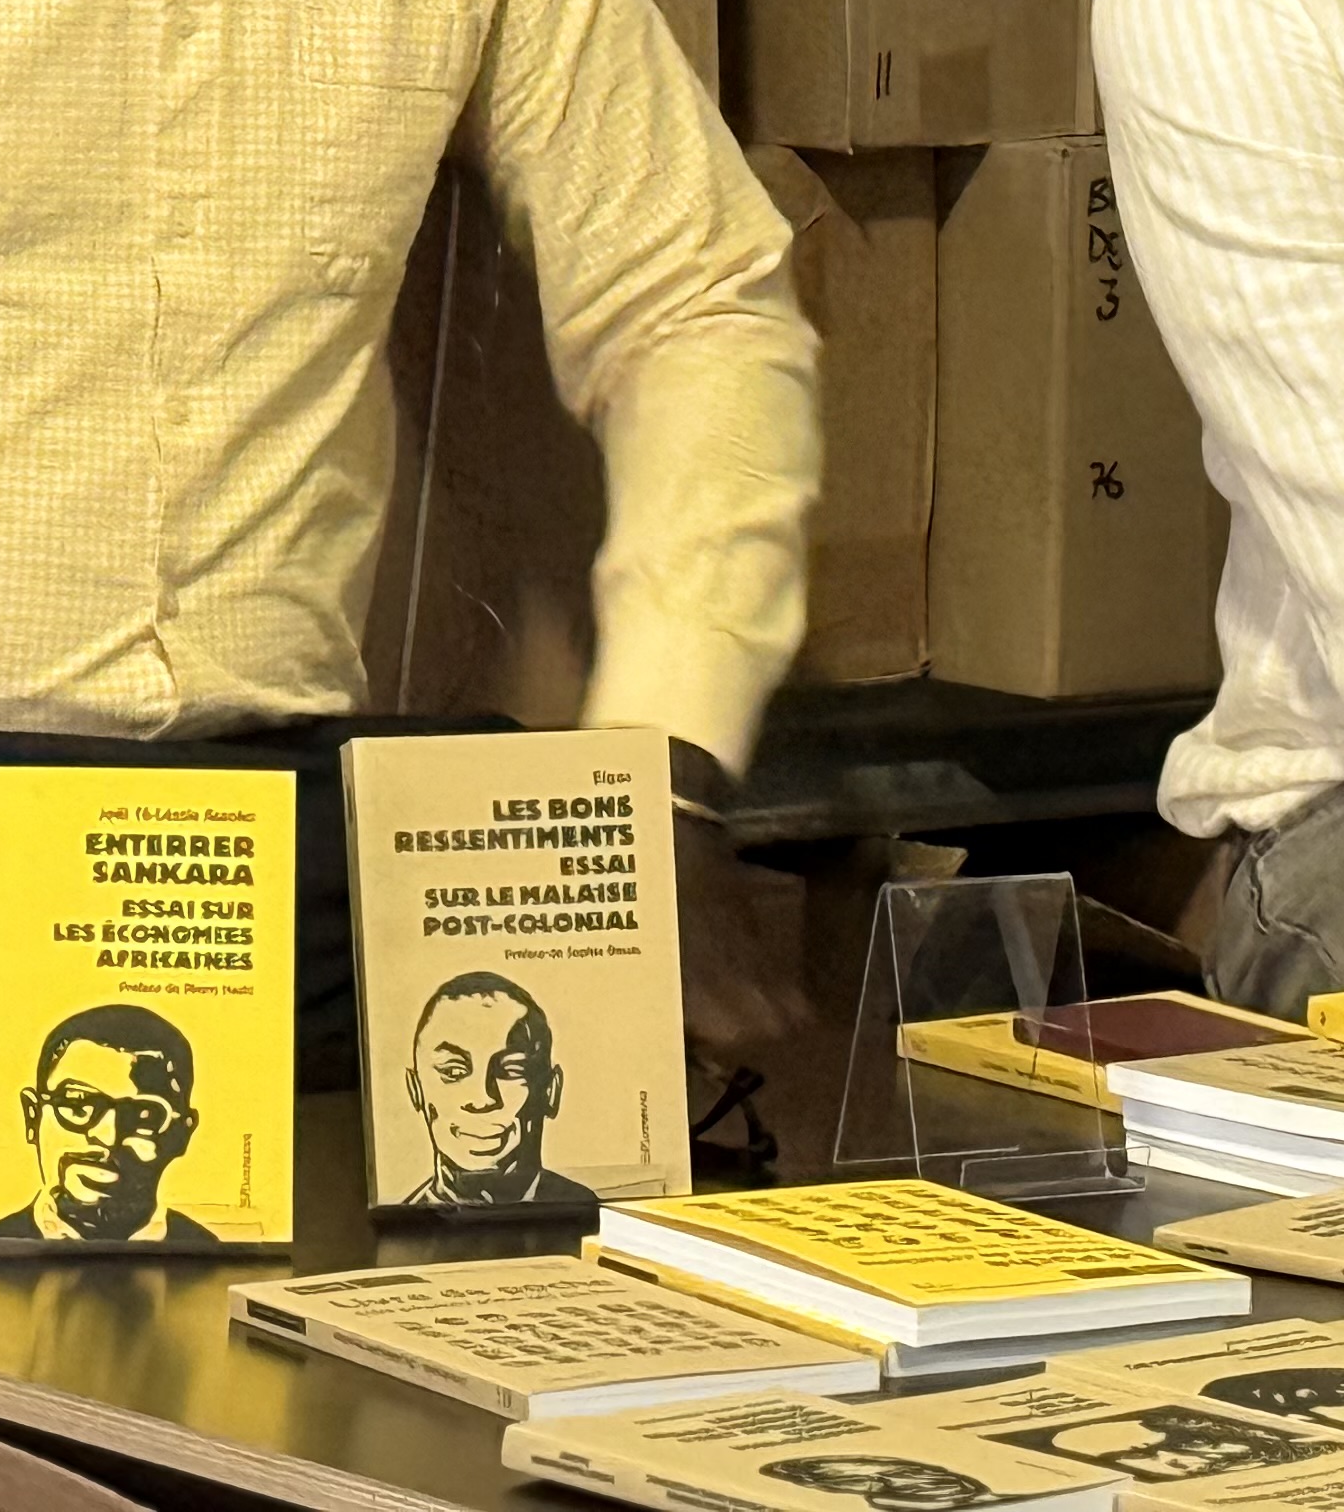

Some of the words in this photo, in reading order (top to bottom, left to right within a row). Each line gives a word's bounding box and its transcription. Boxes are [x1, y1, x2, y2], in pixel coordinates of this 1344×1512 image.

[493, 799, 542, 821] LES
[548, 795, 634, 820] BONS
[85, 833, 255, 858] ENTERRER
[394, 824, 635, 853] RESSENTIMENTS
[93, 861, 255, 886] SANKARA
[560, 854, 636, 876] ESSAI
[424, 888, 480, 908] SUR
[486, 886, 515, 906] LE
[520, 881, 637, 905] MALAISE
[122, 899, 195, 919] ESSAI
[201, 900, 254, 920] SUR
[53, 922, 95, 943] LES
[101, 919, 254, 945] ÉCONOMIES
[423, 910, 639, 937] POST-COLONIAL
[96, 949, 254, 970] AFRICAINES
